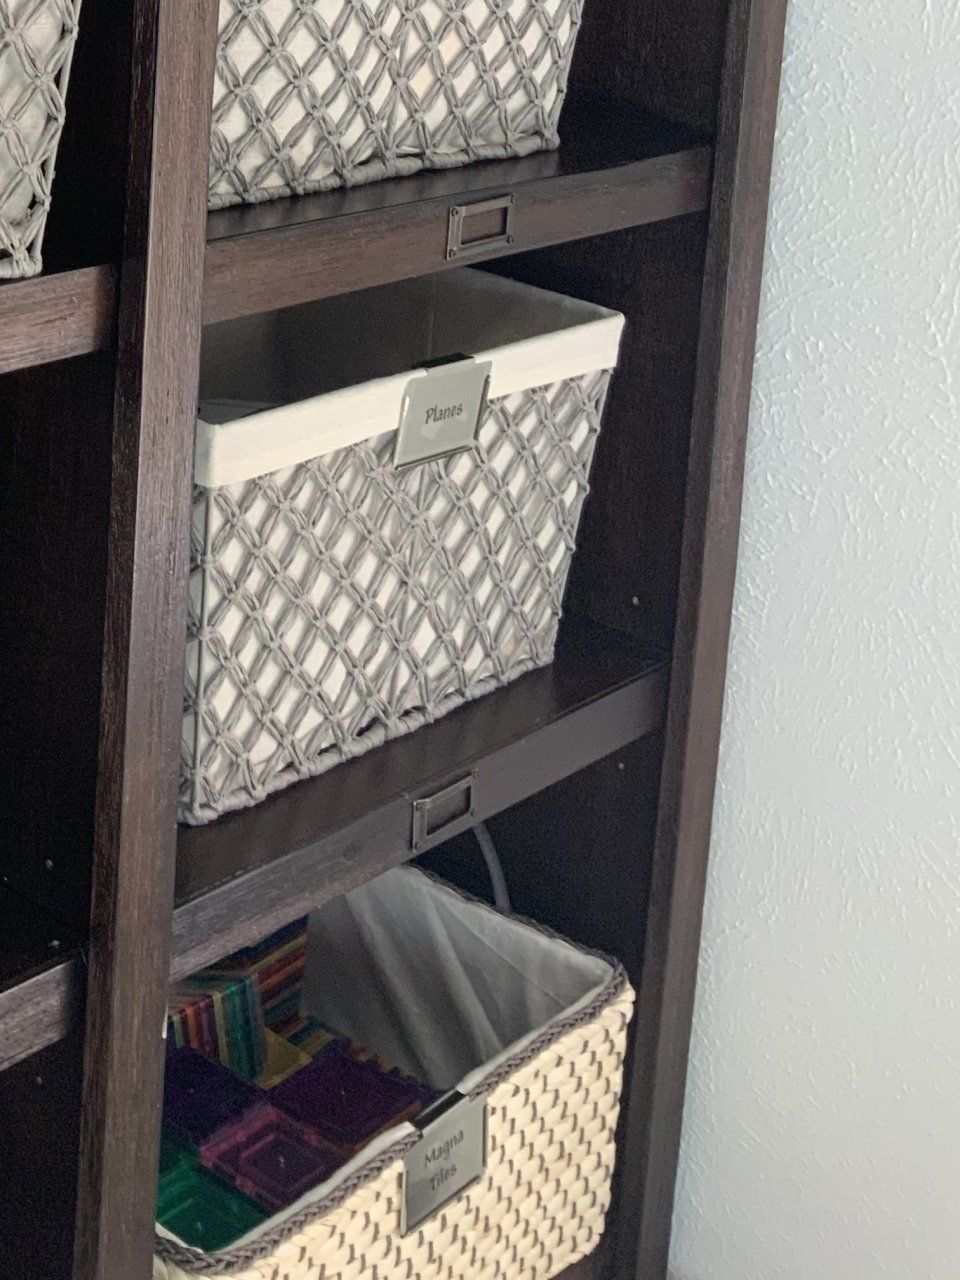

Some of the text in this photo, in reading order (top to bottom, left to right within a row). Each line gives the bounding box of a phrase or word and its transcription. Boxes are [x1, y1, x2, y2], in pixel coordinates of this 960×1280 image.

[425, 403, 463, 425] Planes
[425, 1130, 464, 1168] Magna
[430, 1164, 457, 1191] Tiles
